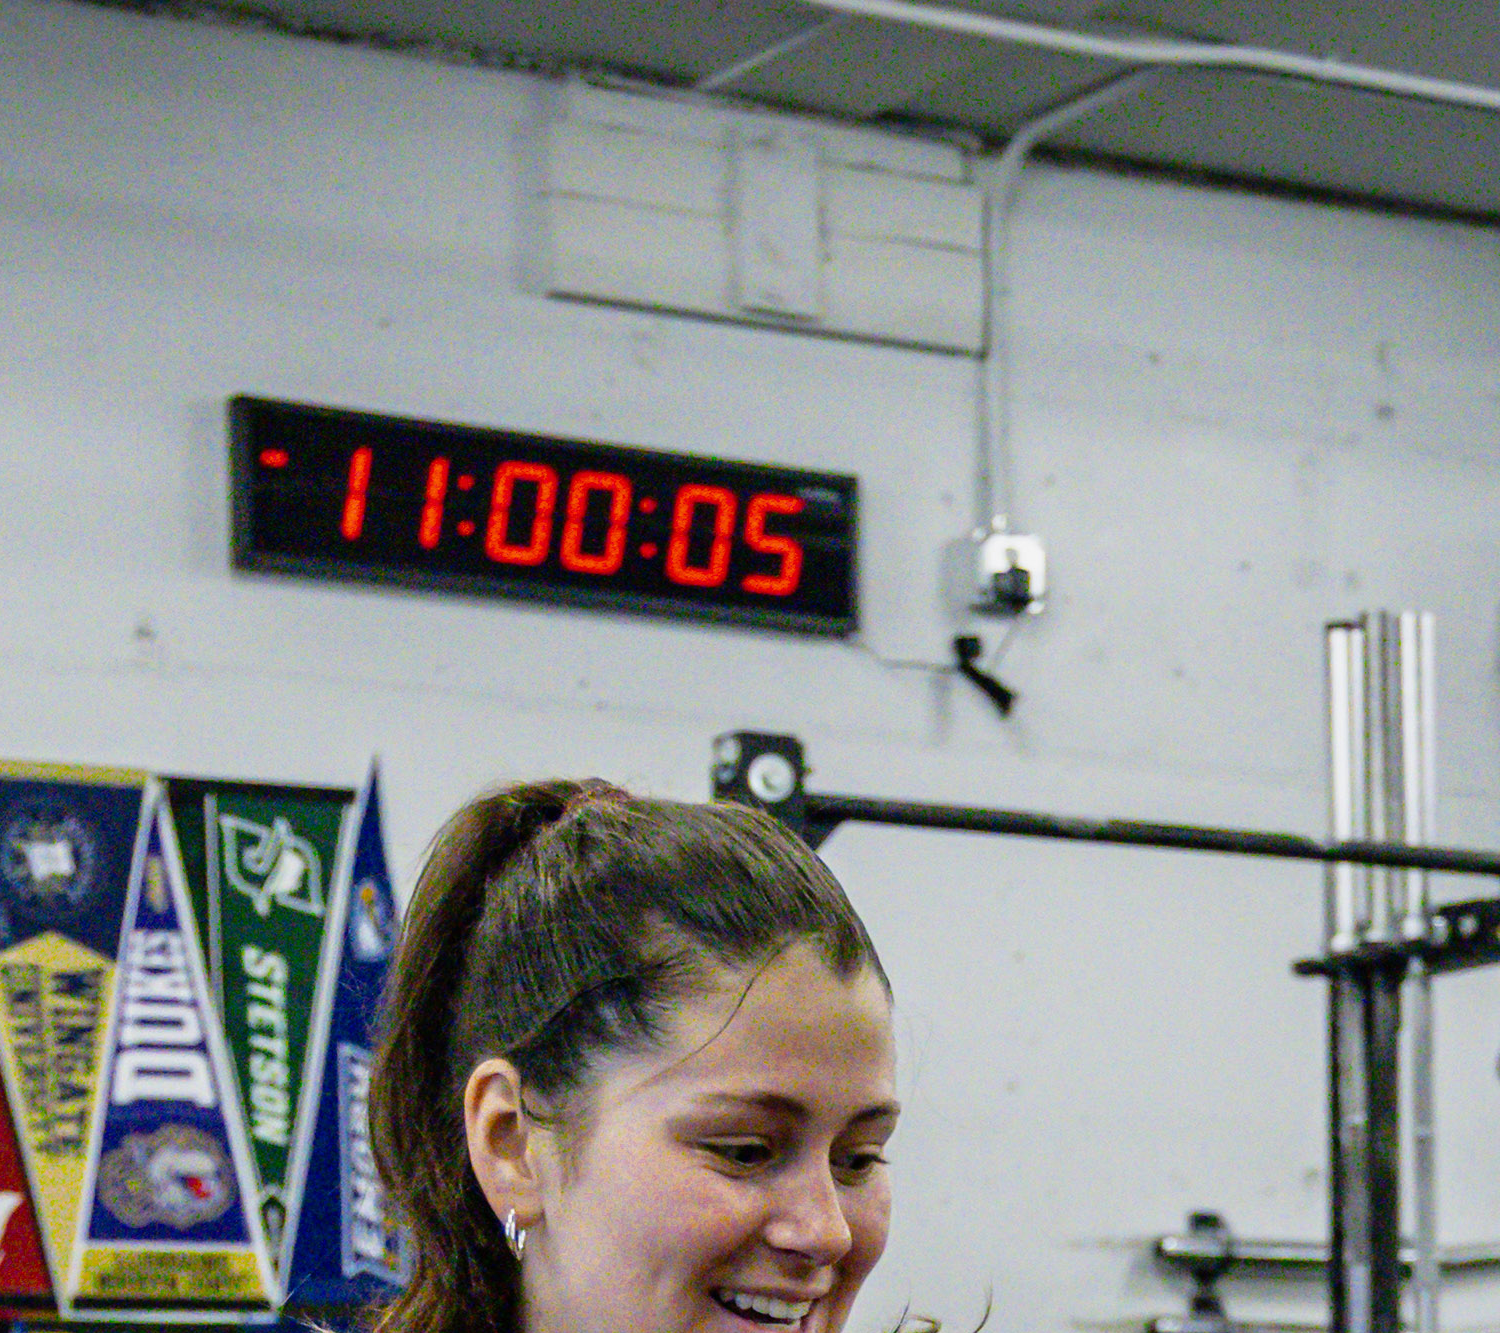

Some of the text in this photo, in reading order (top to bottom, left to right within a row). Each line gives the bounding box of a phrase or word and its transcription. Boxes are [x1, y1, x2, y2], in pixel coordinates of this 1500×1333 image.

[339, 444, 807, 598] 11:00:05
[48, 967, 102, 1158] WINGATE
[112, 929, 219, 1108] DUKES
[241, 944, 290, 1147] STETSON
